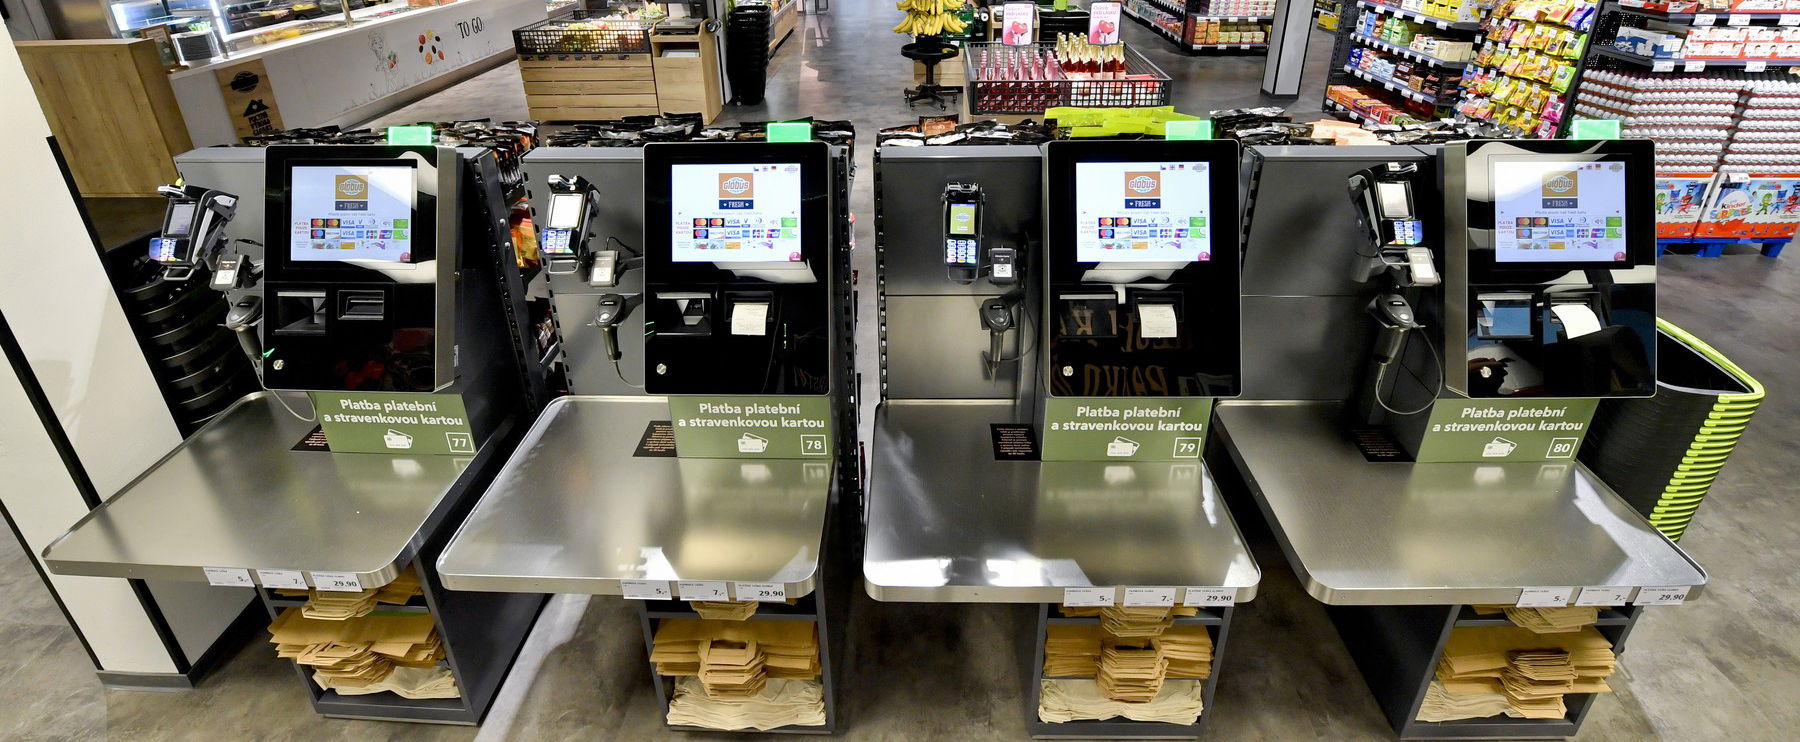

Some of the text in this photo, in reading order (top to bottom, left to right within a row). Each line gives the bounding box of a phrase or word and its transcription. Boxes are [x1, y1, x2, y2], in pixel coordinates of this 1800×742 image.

[458, 17, 482, 38] TO GO
[340, 399, 436, 414] Platba platební
[700, 402, 800, 416] Platba platební
[1076, 406, 1182, 420] Platba platební
[1461, 406, 1568, 420] Platba platební
[324, 413, 463, 426] a stravenkovou kartou
[678, 417, 824, 428] a stravenkovou kartou
[1051, 420, 1202, 431] a stravenkovou kartou
[1432, 420, 1584, 432] a stravenkovou kartou
[452, 438, 466, 448] 77
[806, 440, 822, 450] 78
[1180, 443, 1196, 453] 79
[1554, 443, 1571, 453] 80
